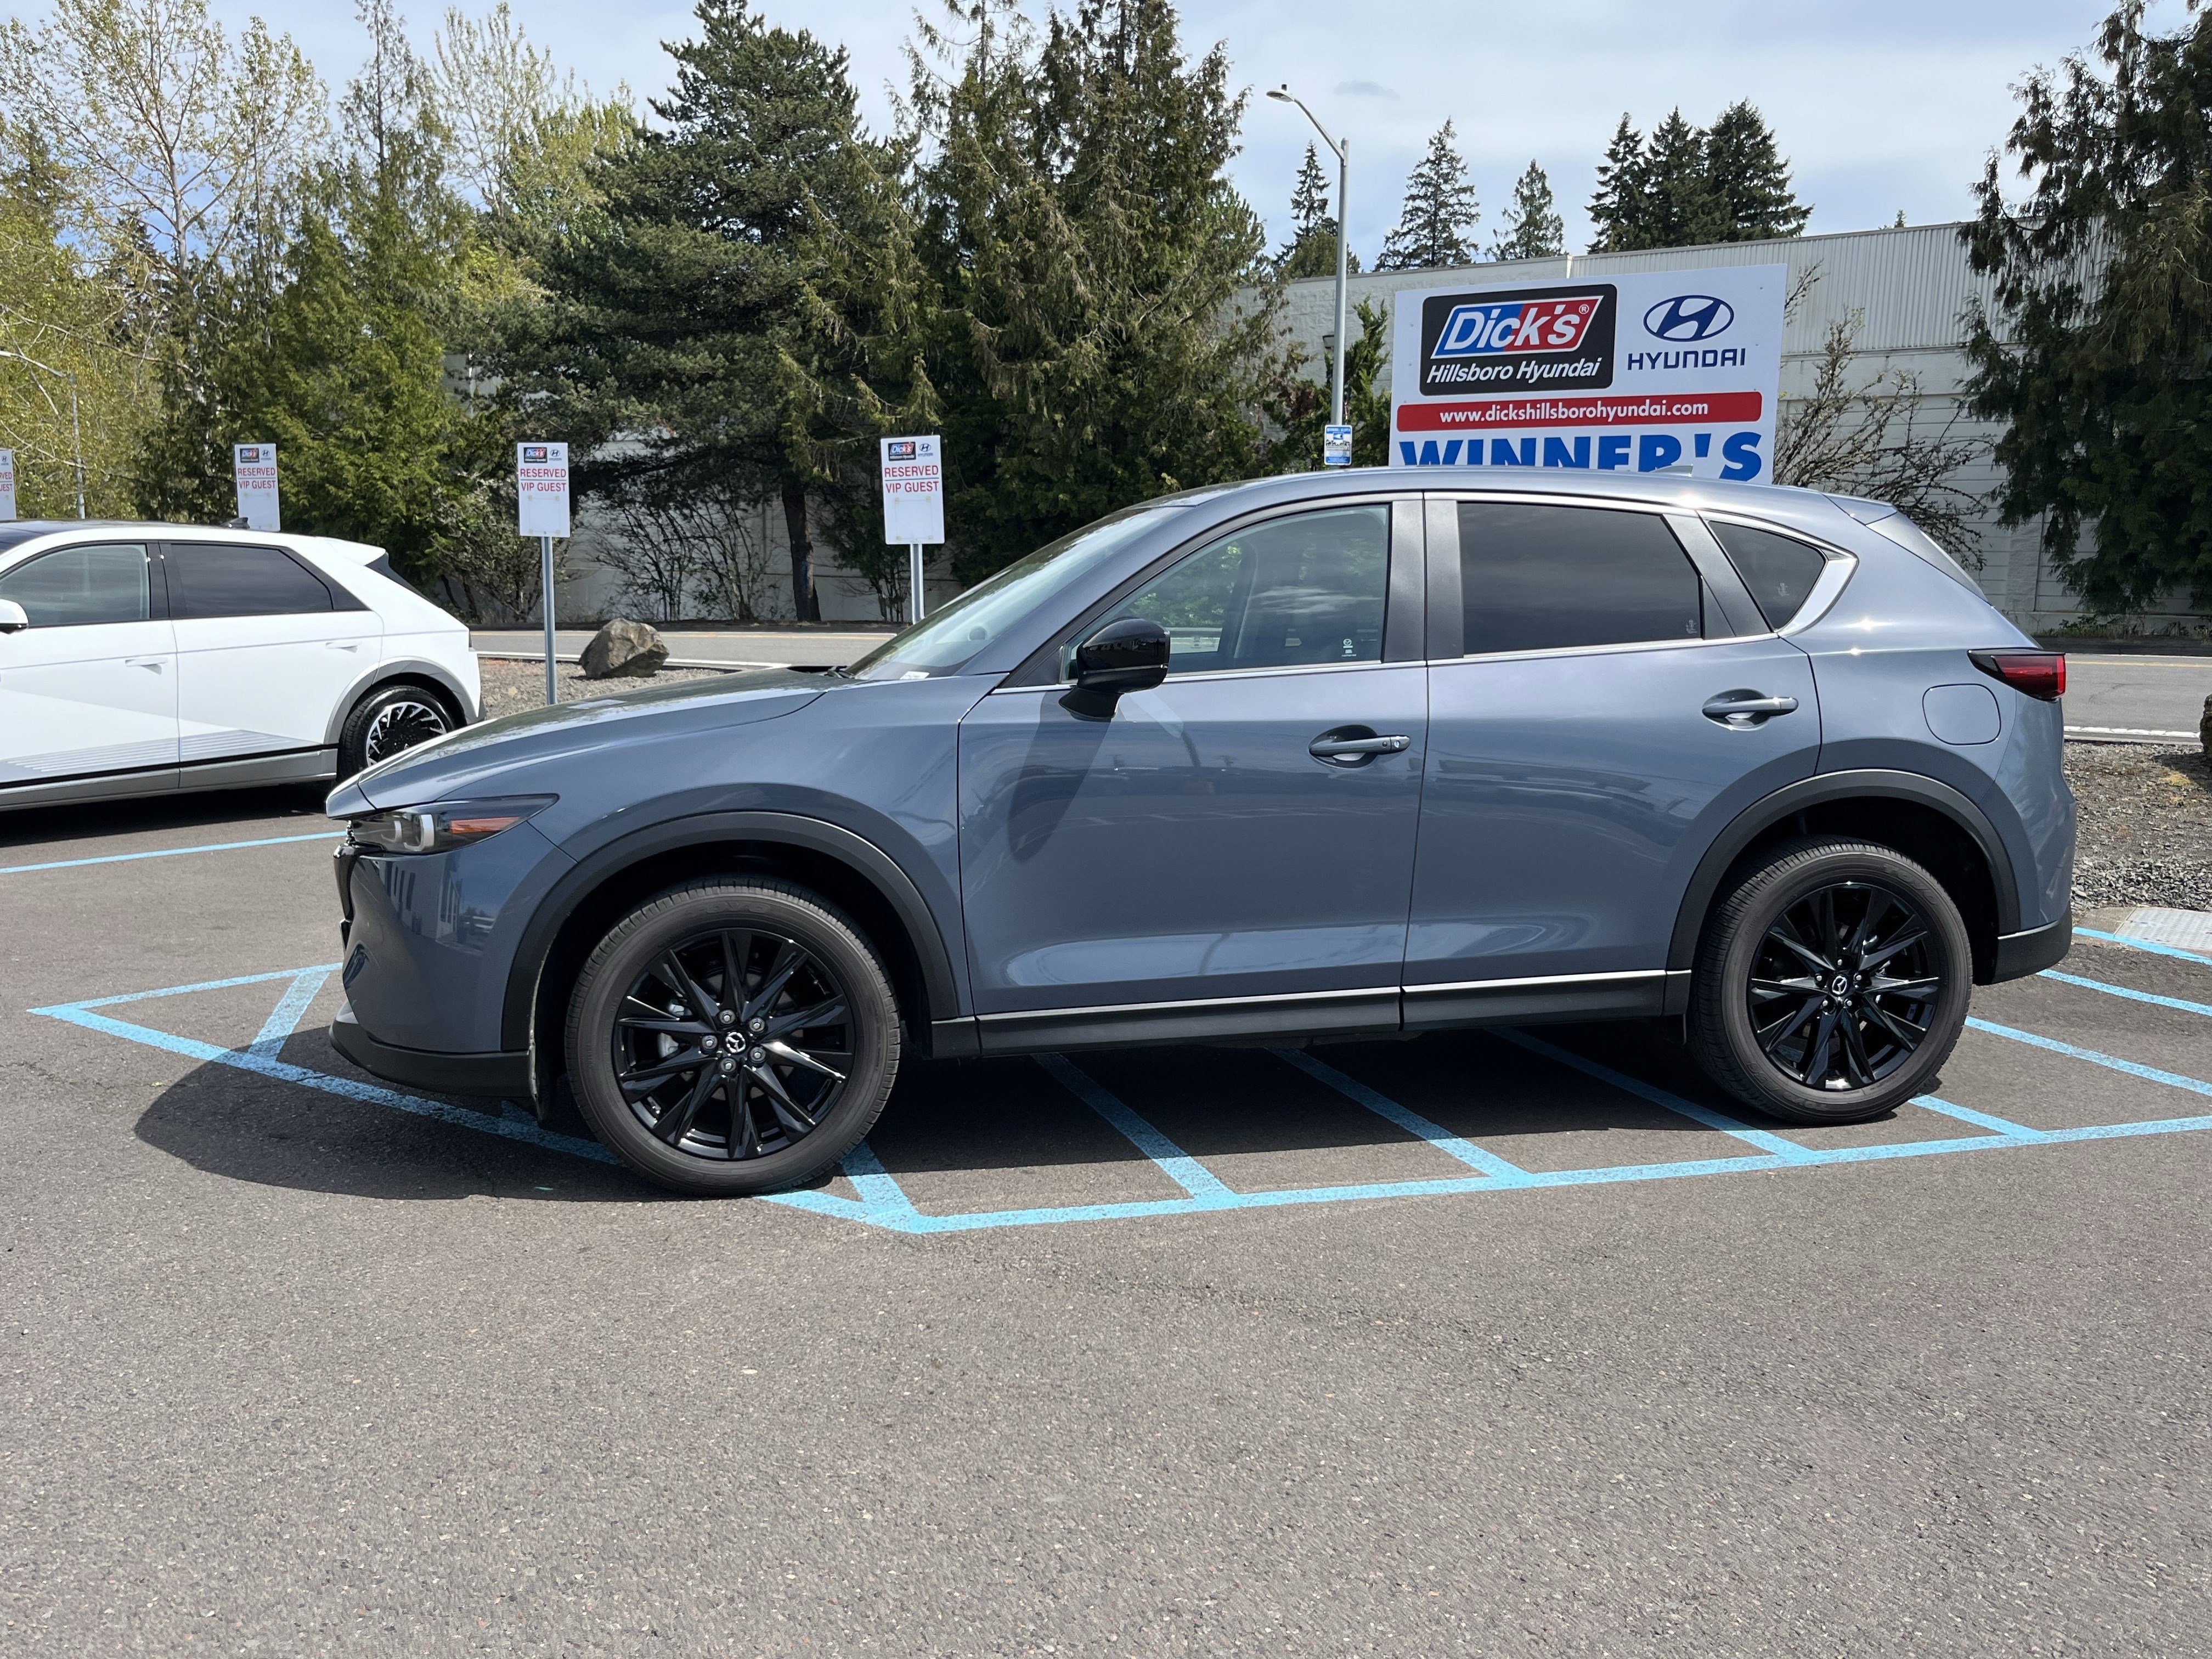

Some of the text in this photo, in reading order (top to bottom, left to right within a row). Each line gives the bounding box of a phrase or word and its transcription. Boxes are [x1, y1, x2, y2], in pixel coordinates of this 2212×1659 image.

[1628, 348, 1745, 371] HYUNDAI
[1427, 358, 1602, 383] Hillsboro Hyundai
[1440, 400, 1708, 423] www.dickshillsborohyundai.com
[238, 467, 275, 476] RESERVED
[520, 469, 566, 478] RESERVED
[884, 465, 939, 478] RESERVED
[239, 481, 276, 489] VIP GUEST
[521, 482, 567, 492] VIP GUEST
[885, 481, 939, 493] VIP GUEST
